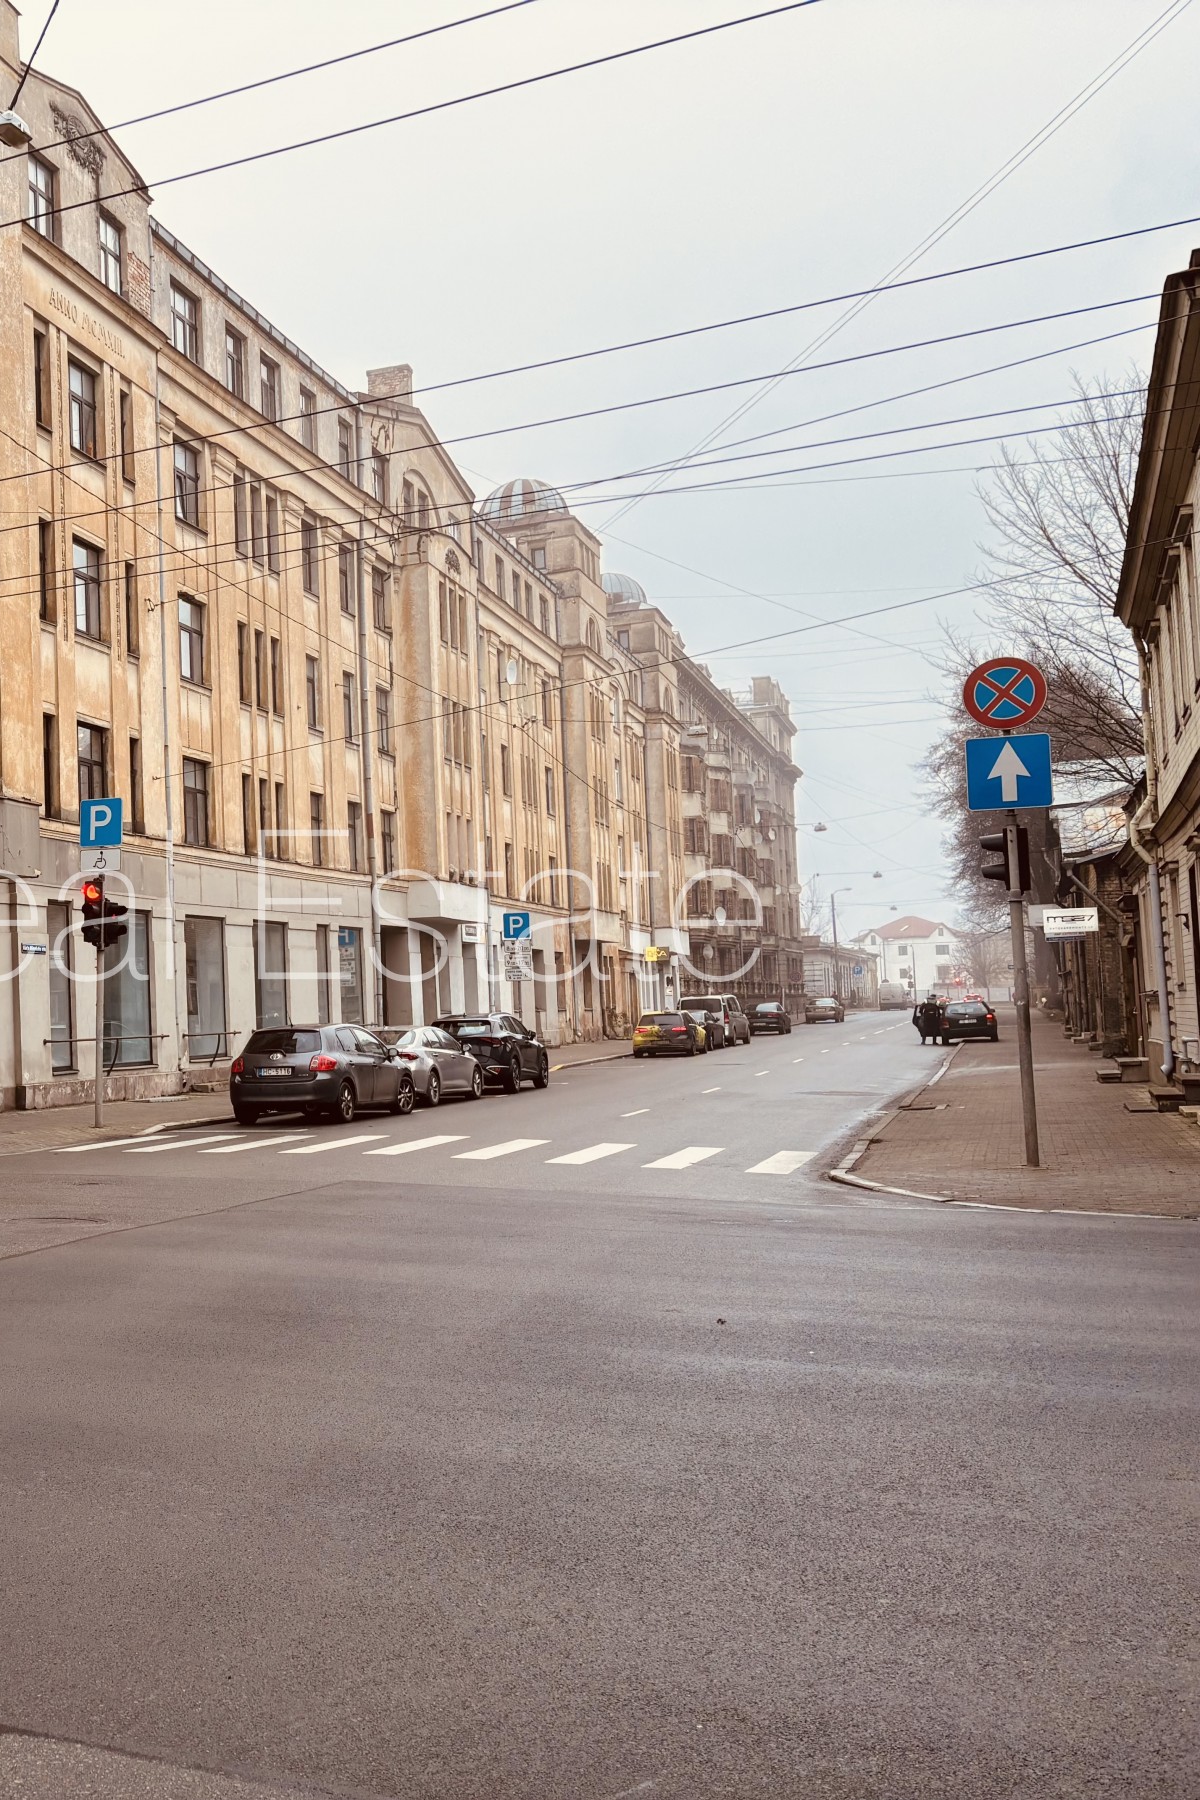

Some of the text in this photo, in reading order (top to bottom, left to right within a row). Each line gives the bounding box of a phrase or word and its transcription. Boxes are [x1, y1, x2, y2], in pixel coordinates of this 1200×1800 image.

[49, 288, 78, 324] ANNO
[90, 805, 112, 841] P
[509, 916, 524, 936] P
